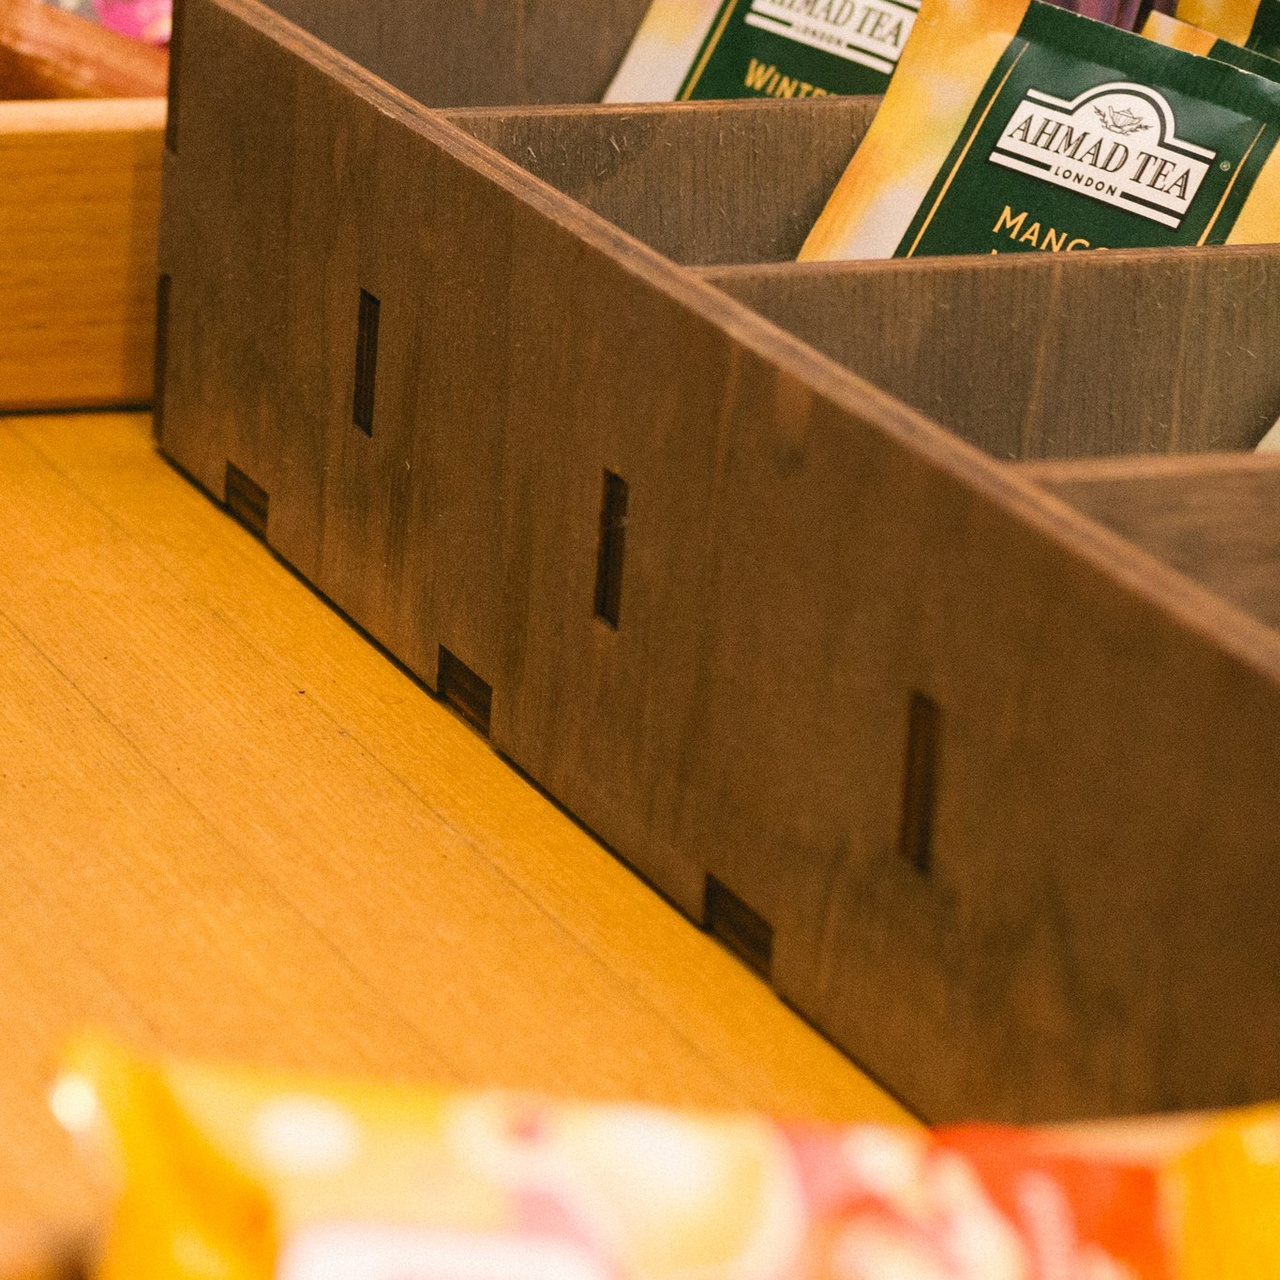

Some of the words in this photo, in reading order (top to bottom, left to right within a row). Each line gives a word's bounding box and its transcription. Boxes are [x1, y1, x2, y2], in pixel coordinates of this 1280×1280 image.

[855, 5, 905, 48] TEA
[744, 58, 840, 99] WINT
[1007, 113, 1129, 173] AHMAD
[1129, 151, 1193, 201] TEA
[1053, 165, 1119, 197] LONDON
[992, 205, 1110, 253] MAN
